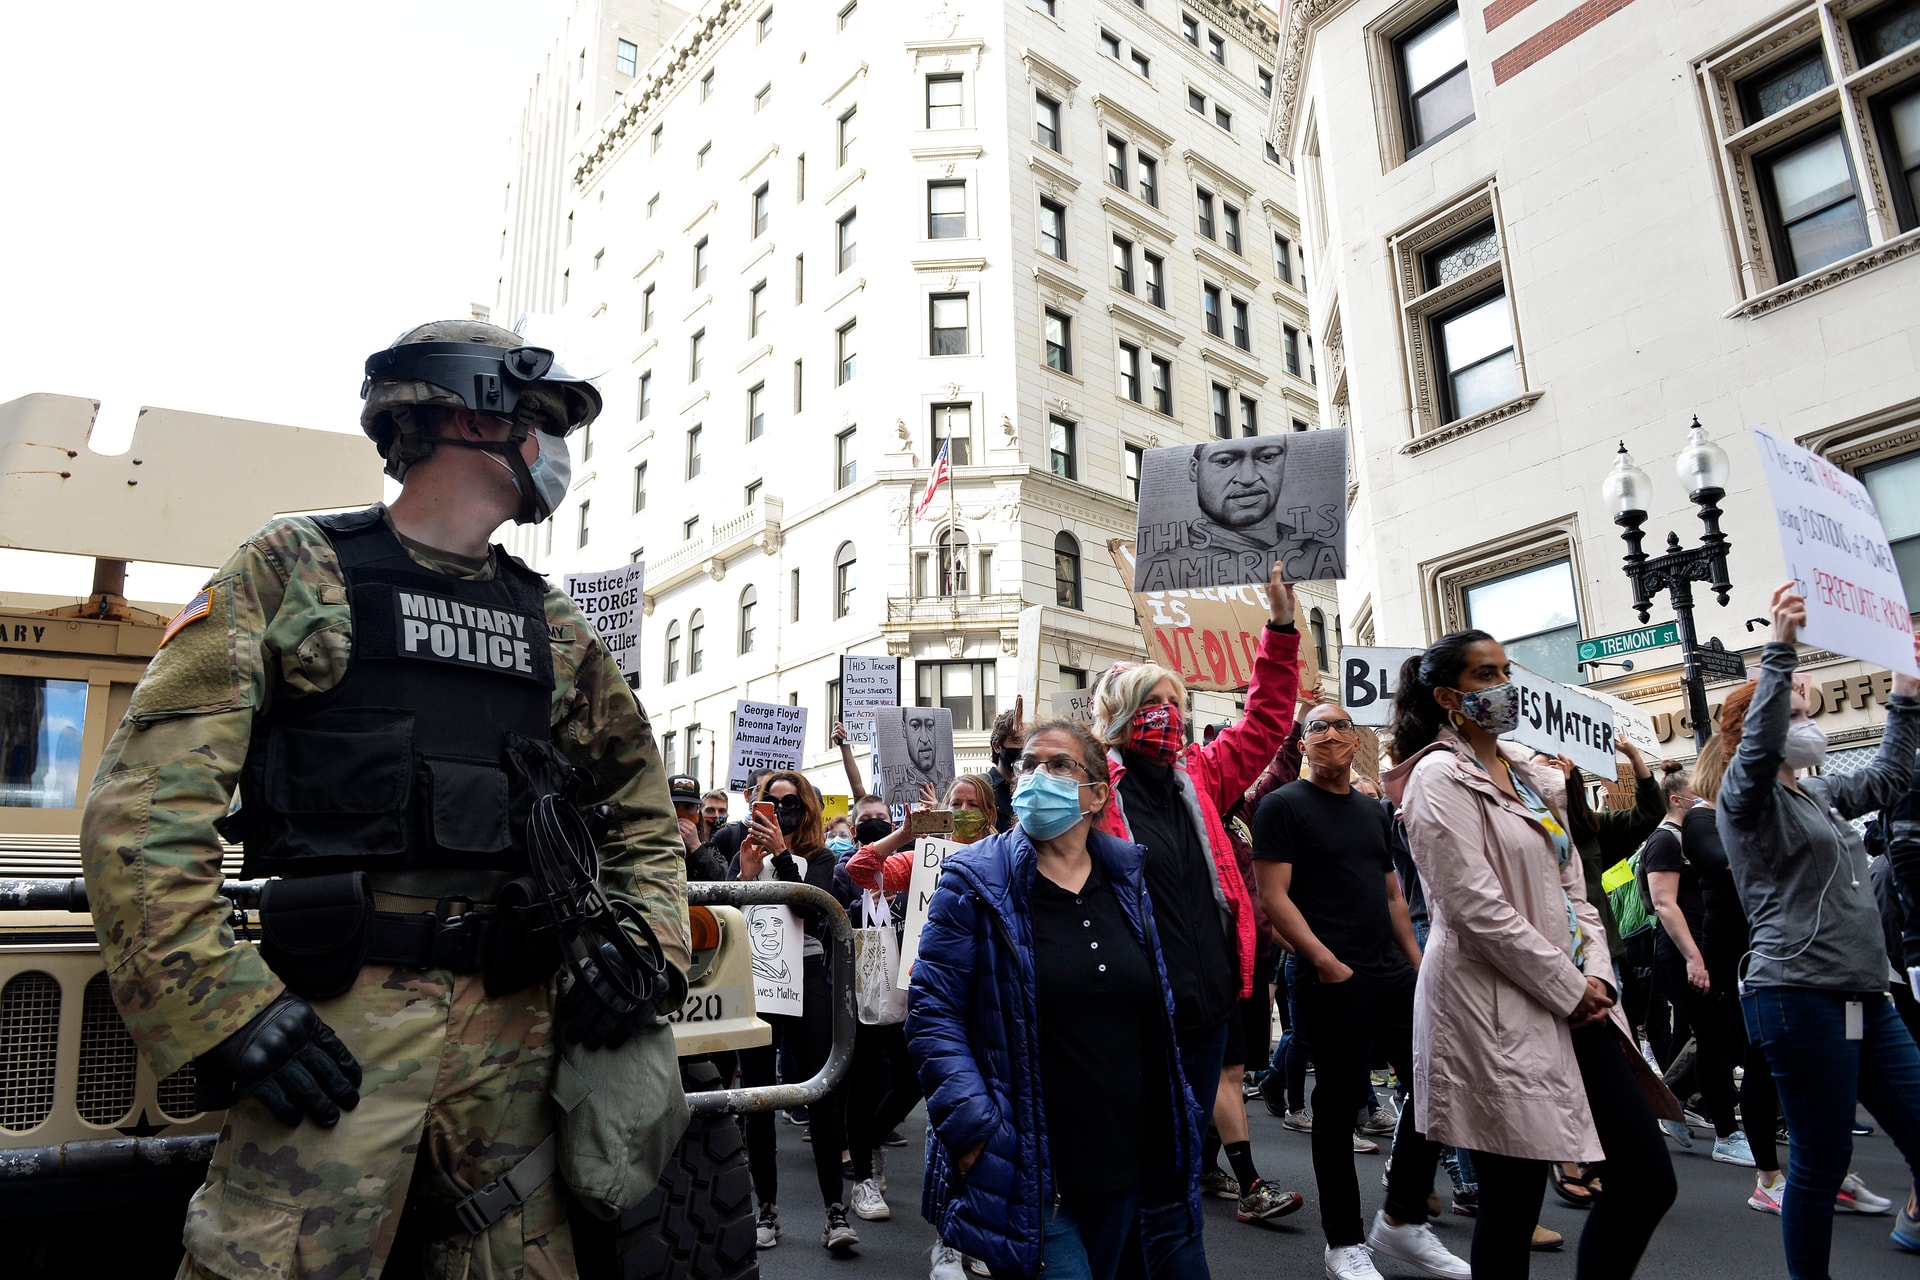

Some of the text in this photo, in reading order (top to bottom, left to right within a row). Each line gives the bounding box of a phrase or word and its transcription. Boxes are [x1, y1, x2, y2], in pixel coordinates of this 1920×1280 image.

[1137, 503, 1340, 554] THIS IS
[1142, 545, 1346, 592] AMERICA
[569, 568, 641, 597] Justice for
[1792, 563, 1808, 599] to
[1813, 567, 1881, 623] PERPETUATE
[399, 592, 525, 638] MILITARY
[1146, 600, 1191, 627] IS
[403, 618, 532, 673] POLICE
[1600, 629, 1674, 655] TREMONT ST
[845, 657, 895, 671] THIS TEACHER
[846, 673, 875, 684] PROTESTS
[848, 687, 892, 695] TEACH STUDENTS
[744, 704, 799, 720] George Floyd
[738, 718, 802, 735] Breonna Taylor
[845, 721, 864, 730] THAT
[1546, 692, 1615, 756] MATTER
[736, 732, 801, 749] Ahmaud Arbery
[738, 757, 795, 771] JUSTICE
[753, 750, 772, 758] many
[882, 764, 917, 786] THIS
[939, 760, 954, 783] IS
[777, 986, 800, 1002] Matter.
